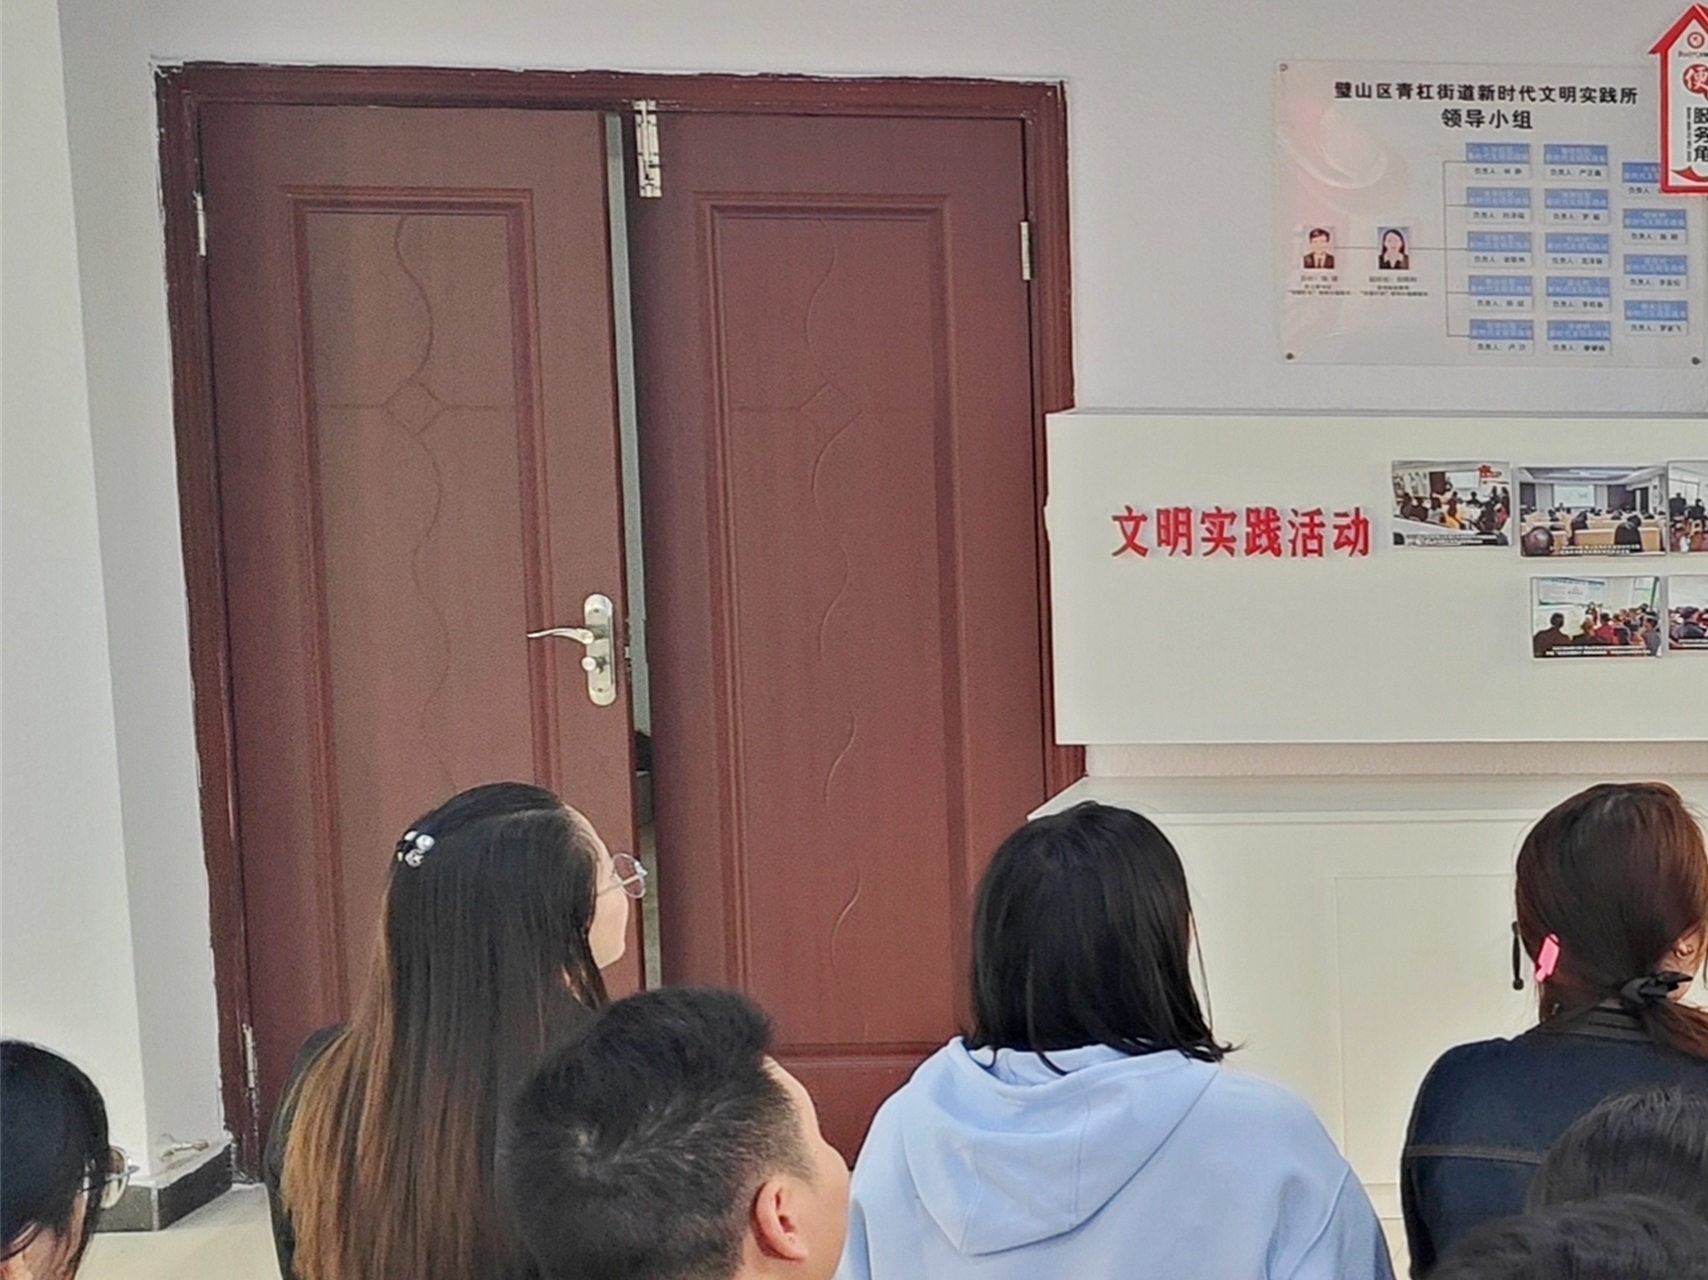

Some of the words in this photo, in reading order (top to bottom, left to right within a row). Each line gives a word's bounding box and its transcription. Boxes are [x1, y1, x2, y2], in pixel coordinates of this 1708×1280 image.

[1440, 106, 1533, 131] 领导小组
[1111, 505, 1371, 558] 文明实践活动
